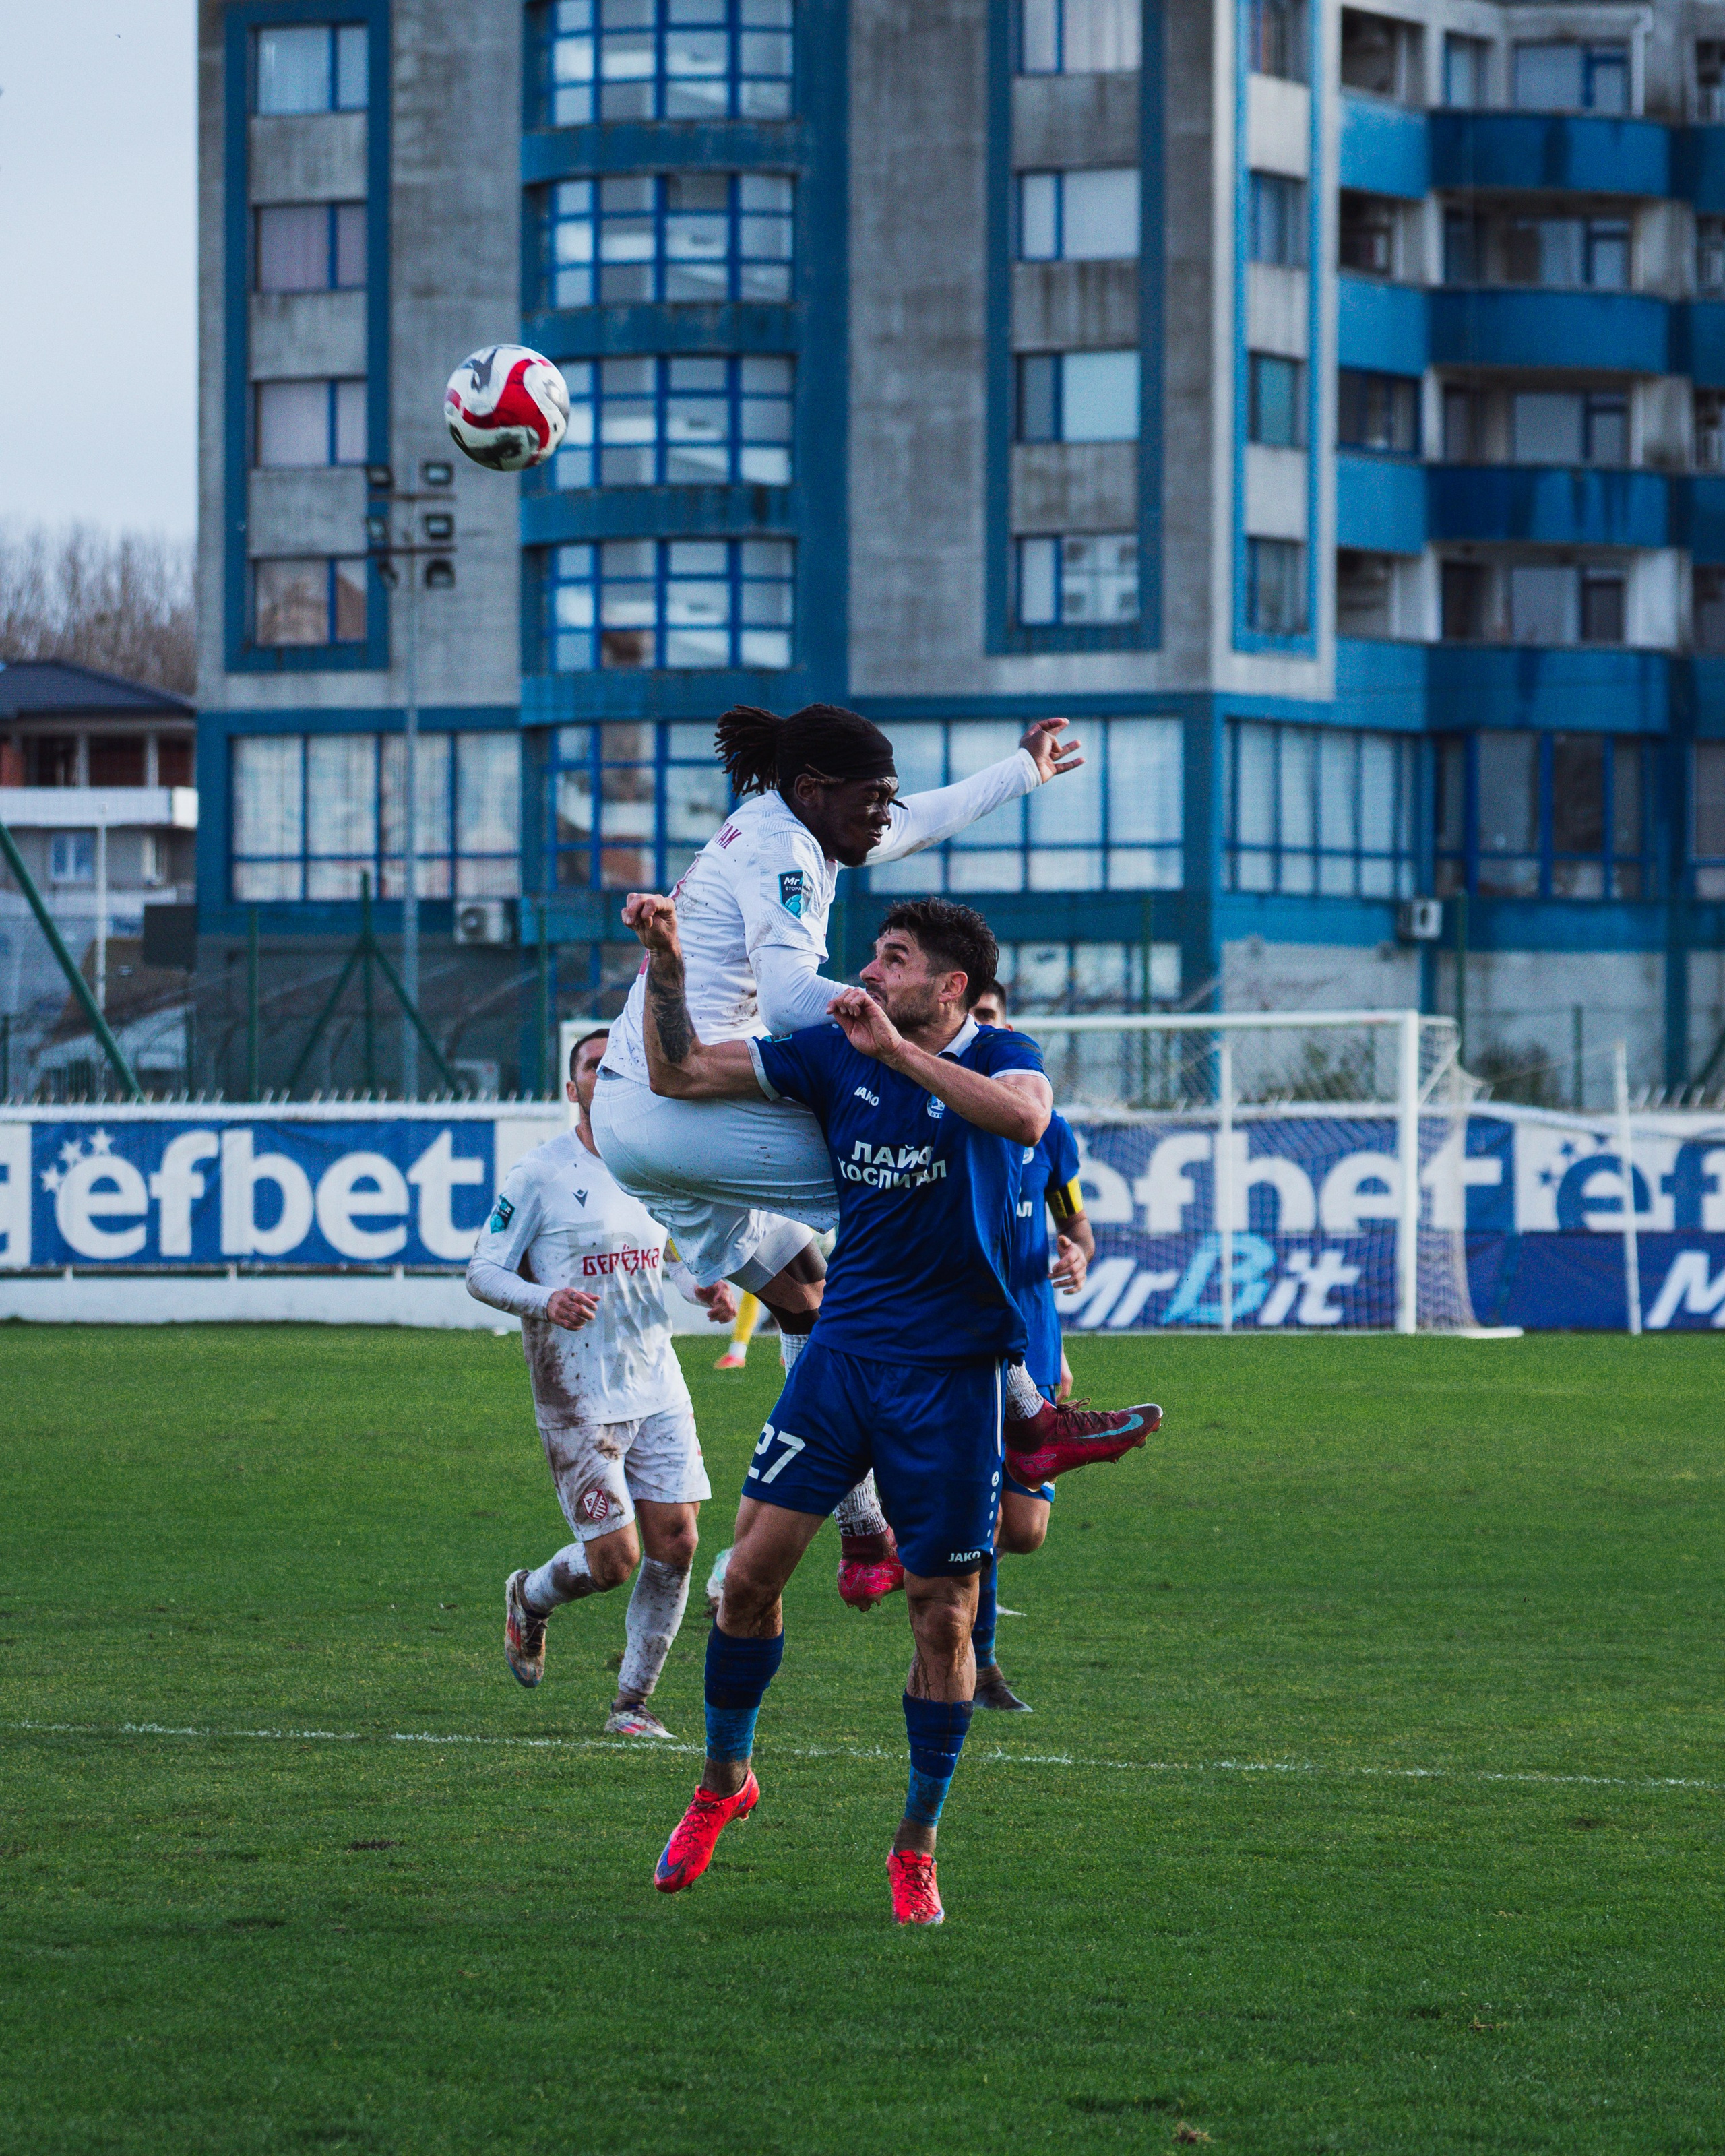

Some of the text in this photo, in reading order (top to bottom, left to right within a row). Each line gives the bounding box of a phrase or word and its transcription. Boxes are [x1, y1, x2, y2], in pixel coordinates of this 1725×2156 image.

[55, 1128, 484, 1260] efbet
[748, 1422, 806, 1484] 27
[947, 1550, 981, 1562] JAKO
